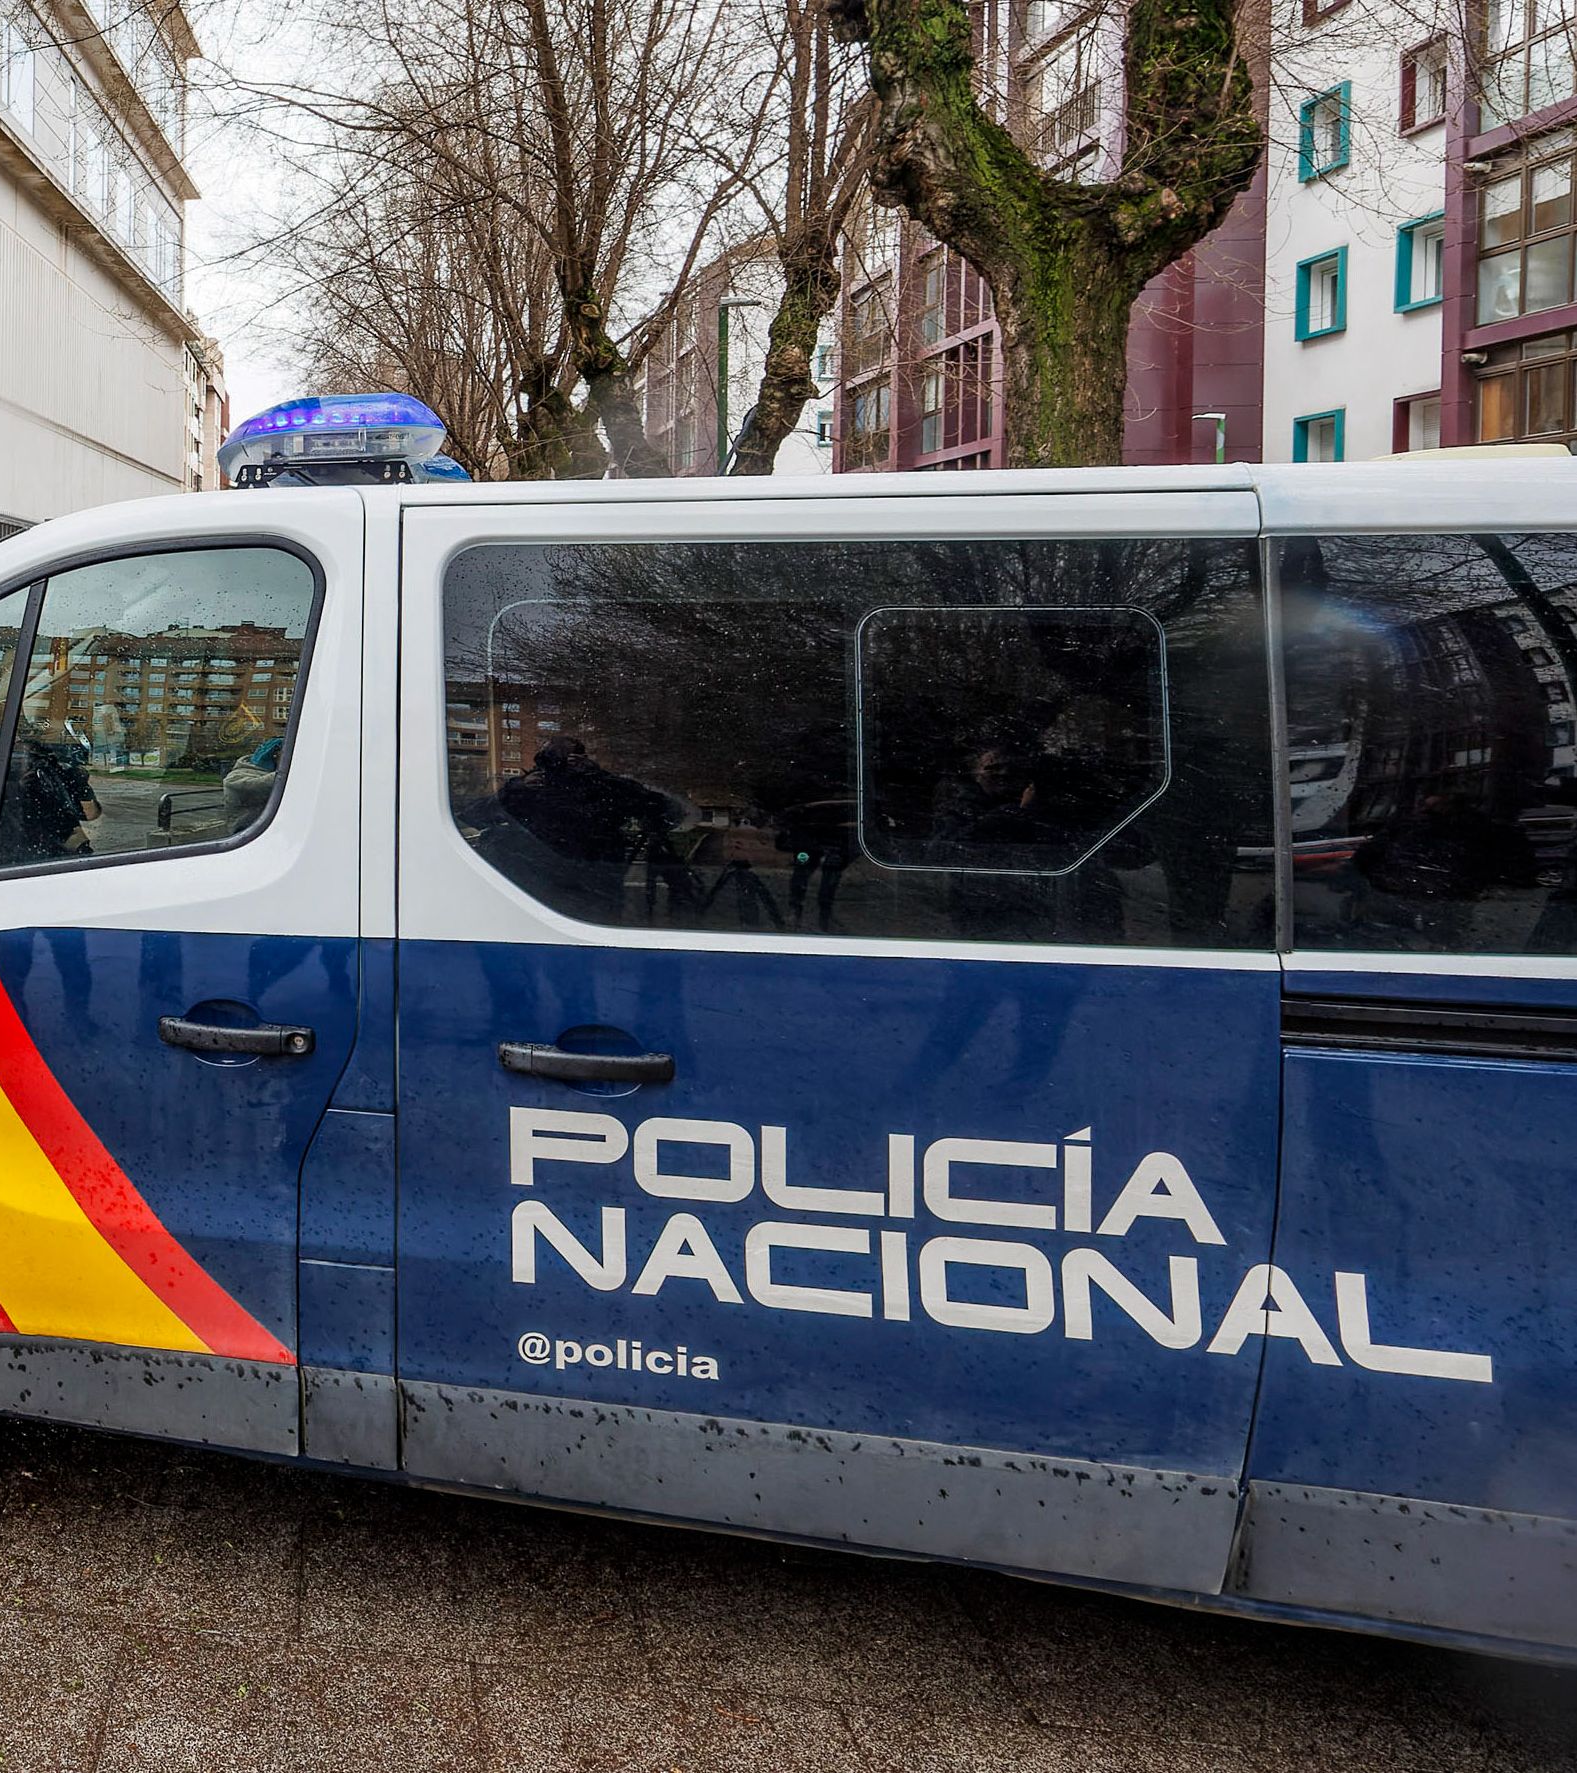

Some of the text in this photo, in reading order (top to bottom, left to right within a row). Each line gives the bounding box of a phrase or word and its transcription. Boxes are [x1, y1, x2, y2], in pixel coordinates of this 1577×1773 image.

[509, 1106, 1228, 1246] POLICÍA
[511, 1199, 1494, 1383] NACIONAL
[517, 1331, 720, 1381] @policia
